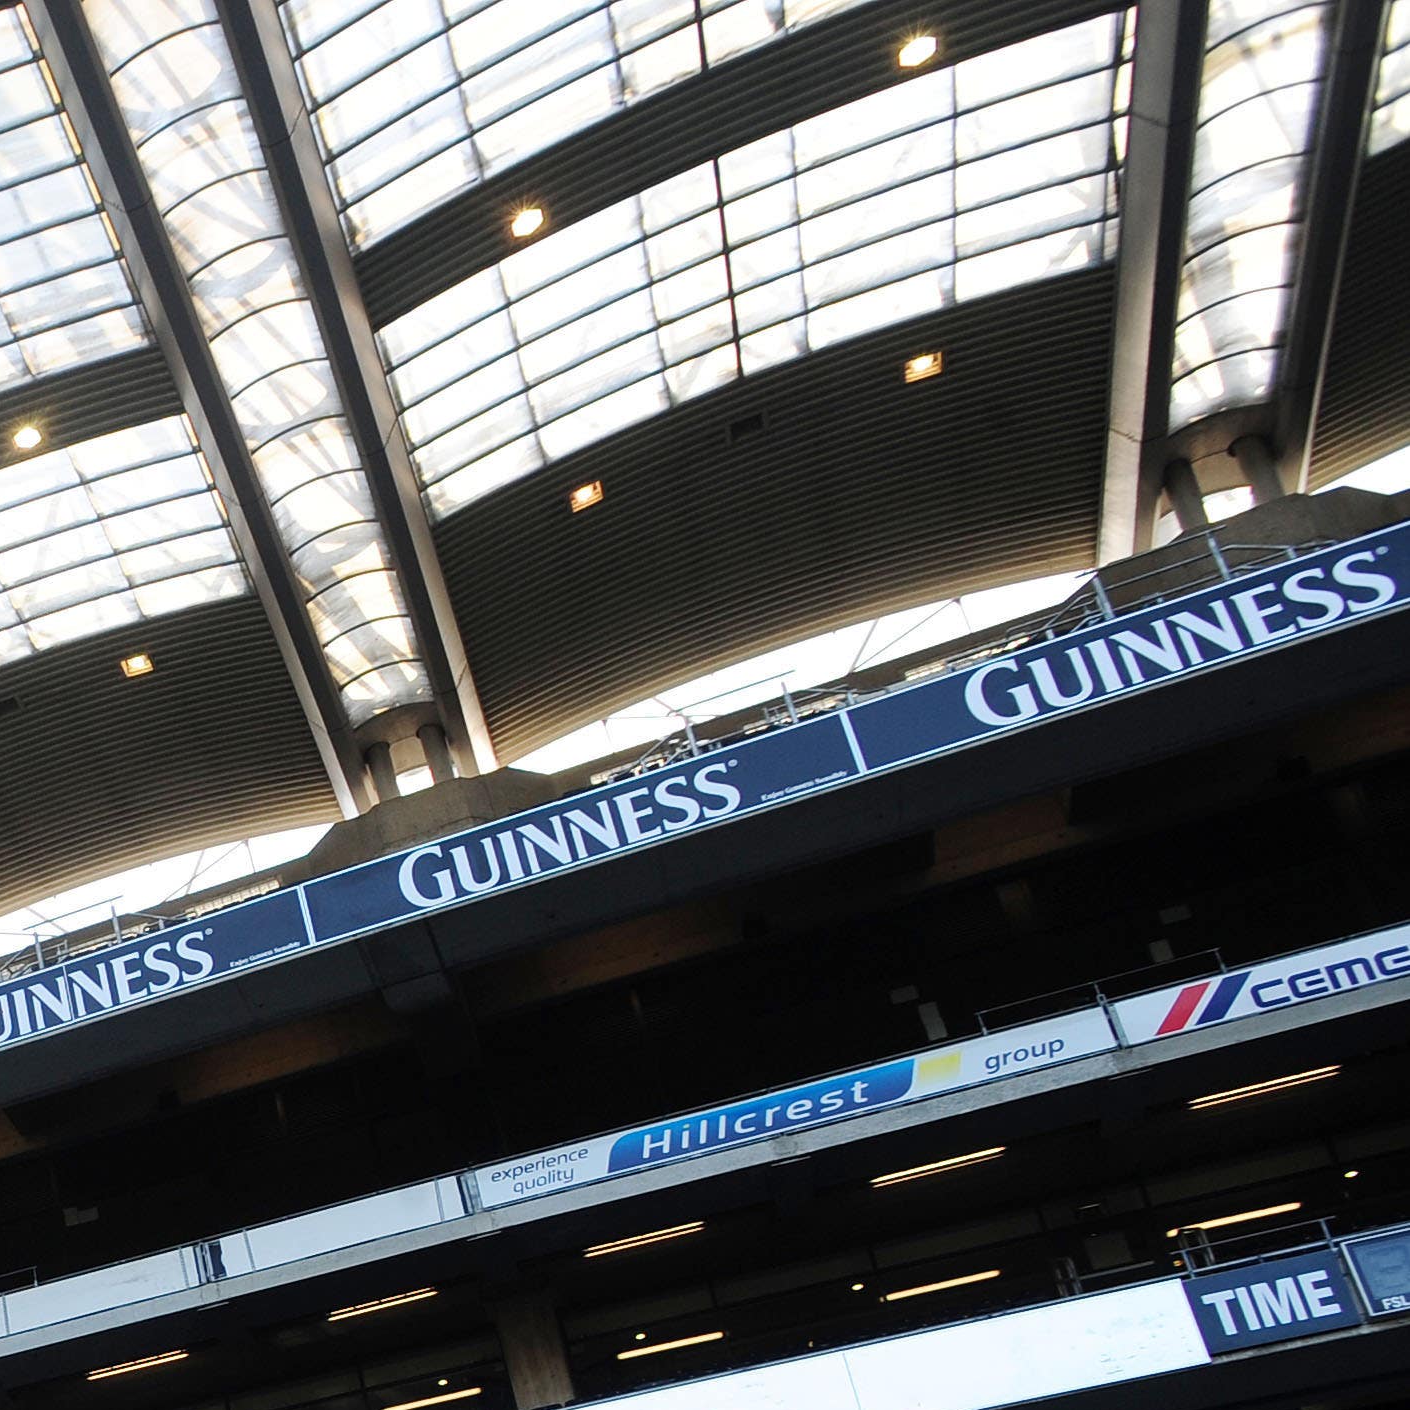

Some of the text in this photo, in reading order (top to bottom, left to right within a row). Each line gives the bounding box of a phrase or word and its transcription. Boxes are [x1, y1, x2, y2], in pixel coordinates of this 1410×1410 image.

[964, 551, 1397, 726] GUINNESS
[398, 762, 741, 908] GUINNESS
[984, 1037, 1065, 1074] group
[641, 1080, 870, 1159] Hillcrest
[490, 1147, 589, 1183] experience
[513, 1168, 574, 1194] quality
[1200, 1269, 1342, 1336] TIME
